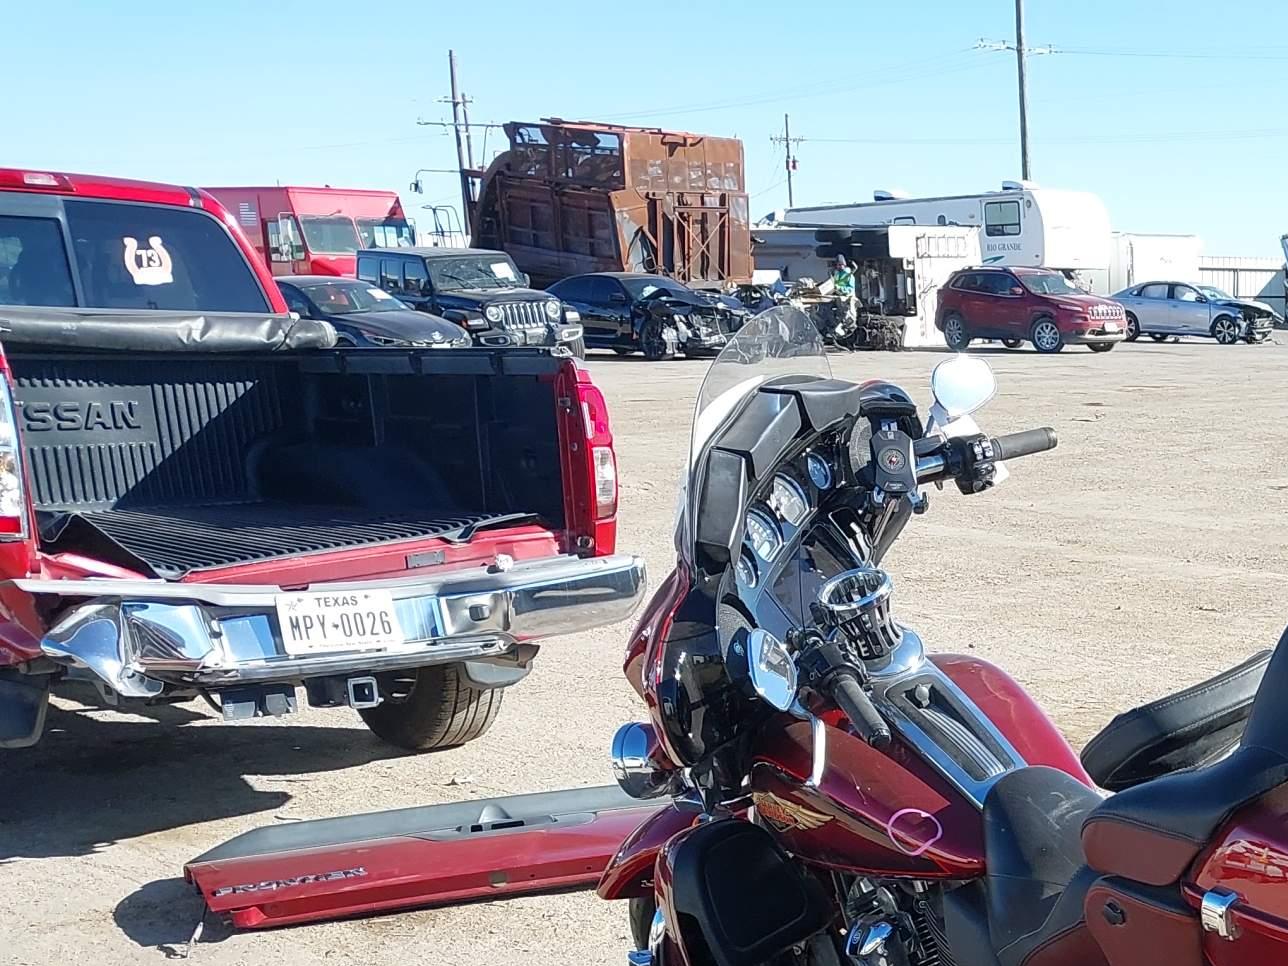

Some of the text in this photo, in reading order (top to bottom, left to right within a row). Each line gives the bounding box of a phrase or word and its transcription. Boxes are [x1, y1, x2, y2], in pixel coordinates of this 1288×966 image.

[986, 243, 998, 252] RIO
[20, 401, 141, 432] SSAN
[315, 595, 359, 608] TEXAS
